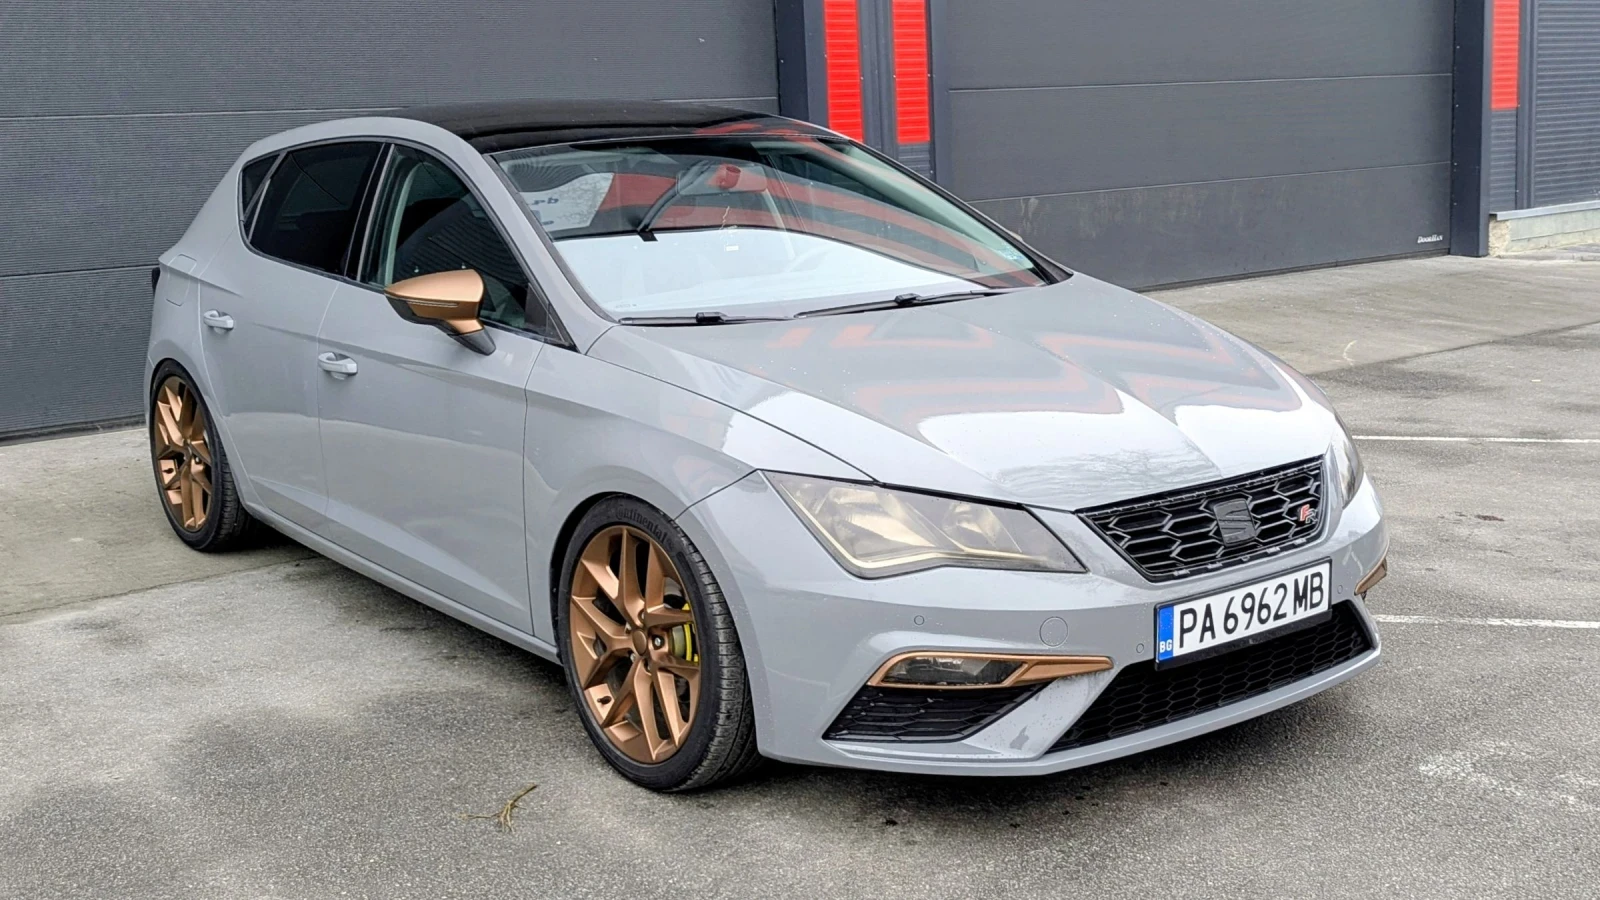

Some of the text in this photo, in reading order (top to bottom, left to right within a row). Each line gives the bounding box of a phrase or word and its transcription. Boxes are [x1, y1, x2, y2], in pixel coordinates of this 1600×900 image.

[615, 504, 668, 544] Continental
[1179, 571, 1324, 649] PA 6962 MB
[1159, 639, 1173, 653] BG
